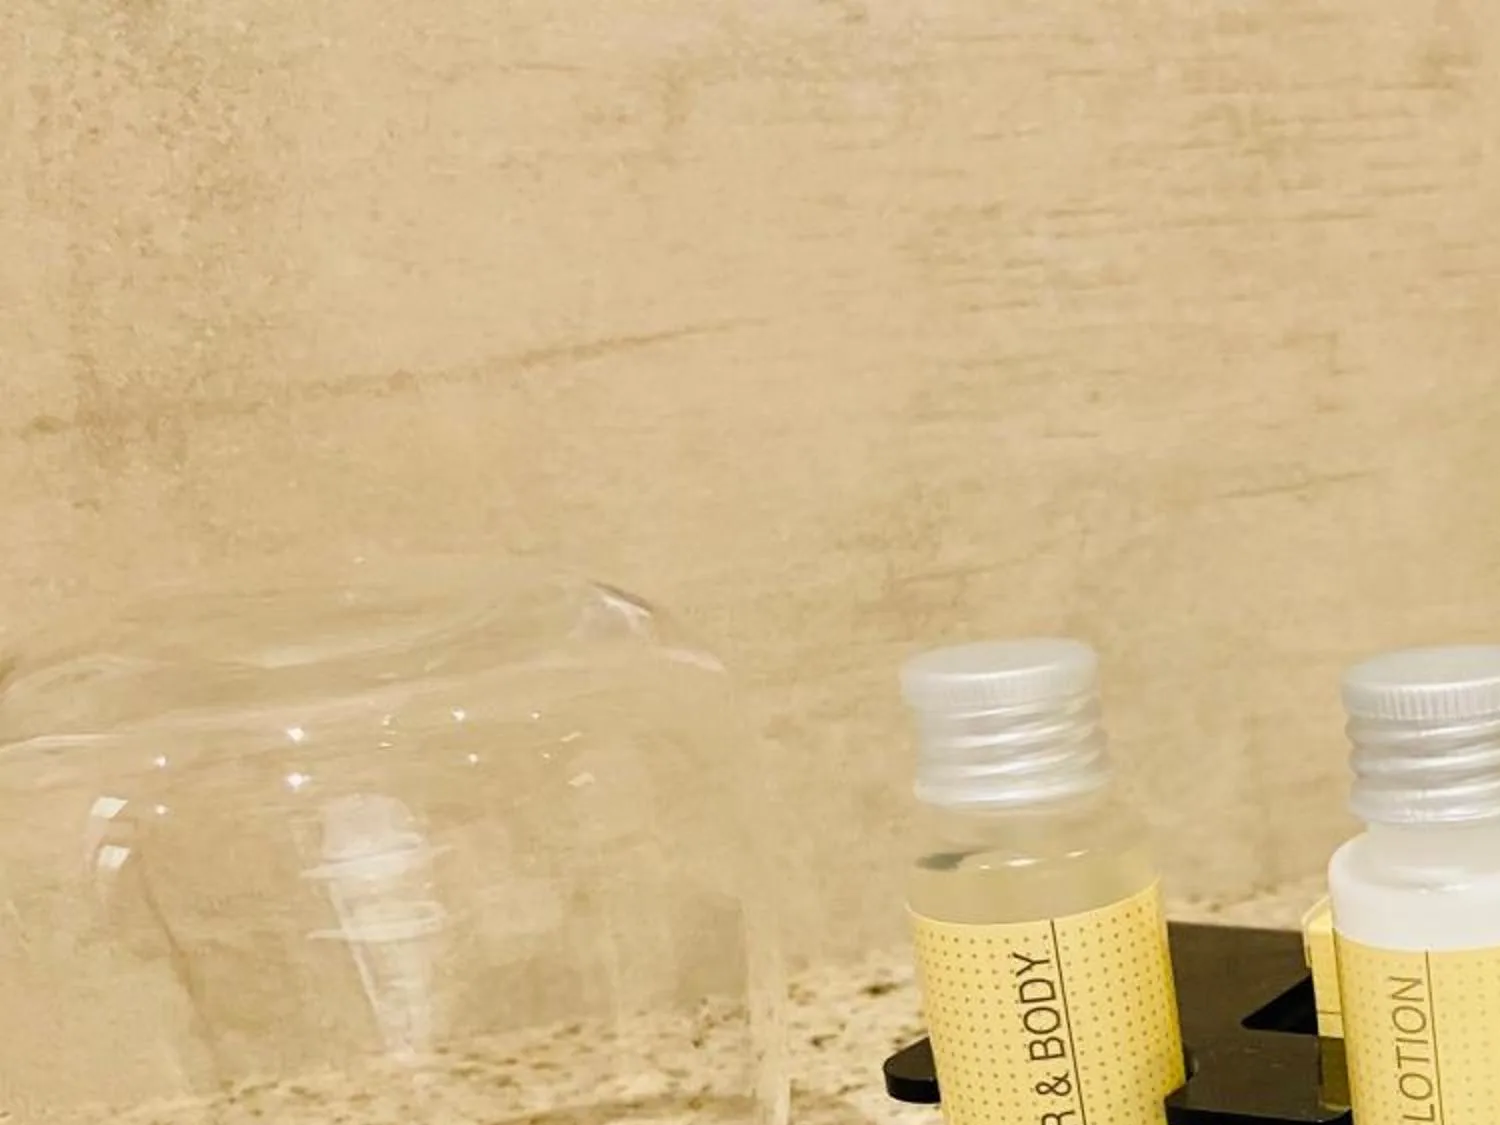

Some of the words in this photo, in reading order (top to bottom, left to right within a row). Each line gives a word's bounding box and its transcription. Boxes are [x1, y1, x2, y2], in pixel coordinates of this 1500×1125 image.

[1013, 952, 1065, 1061] BODY
[1391, 976, 1435, 1123] LOTION
[1036, 1073, 1073, 1099] &
